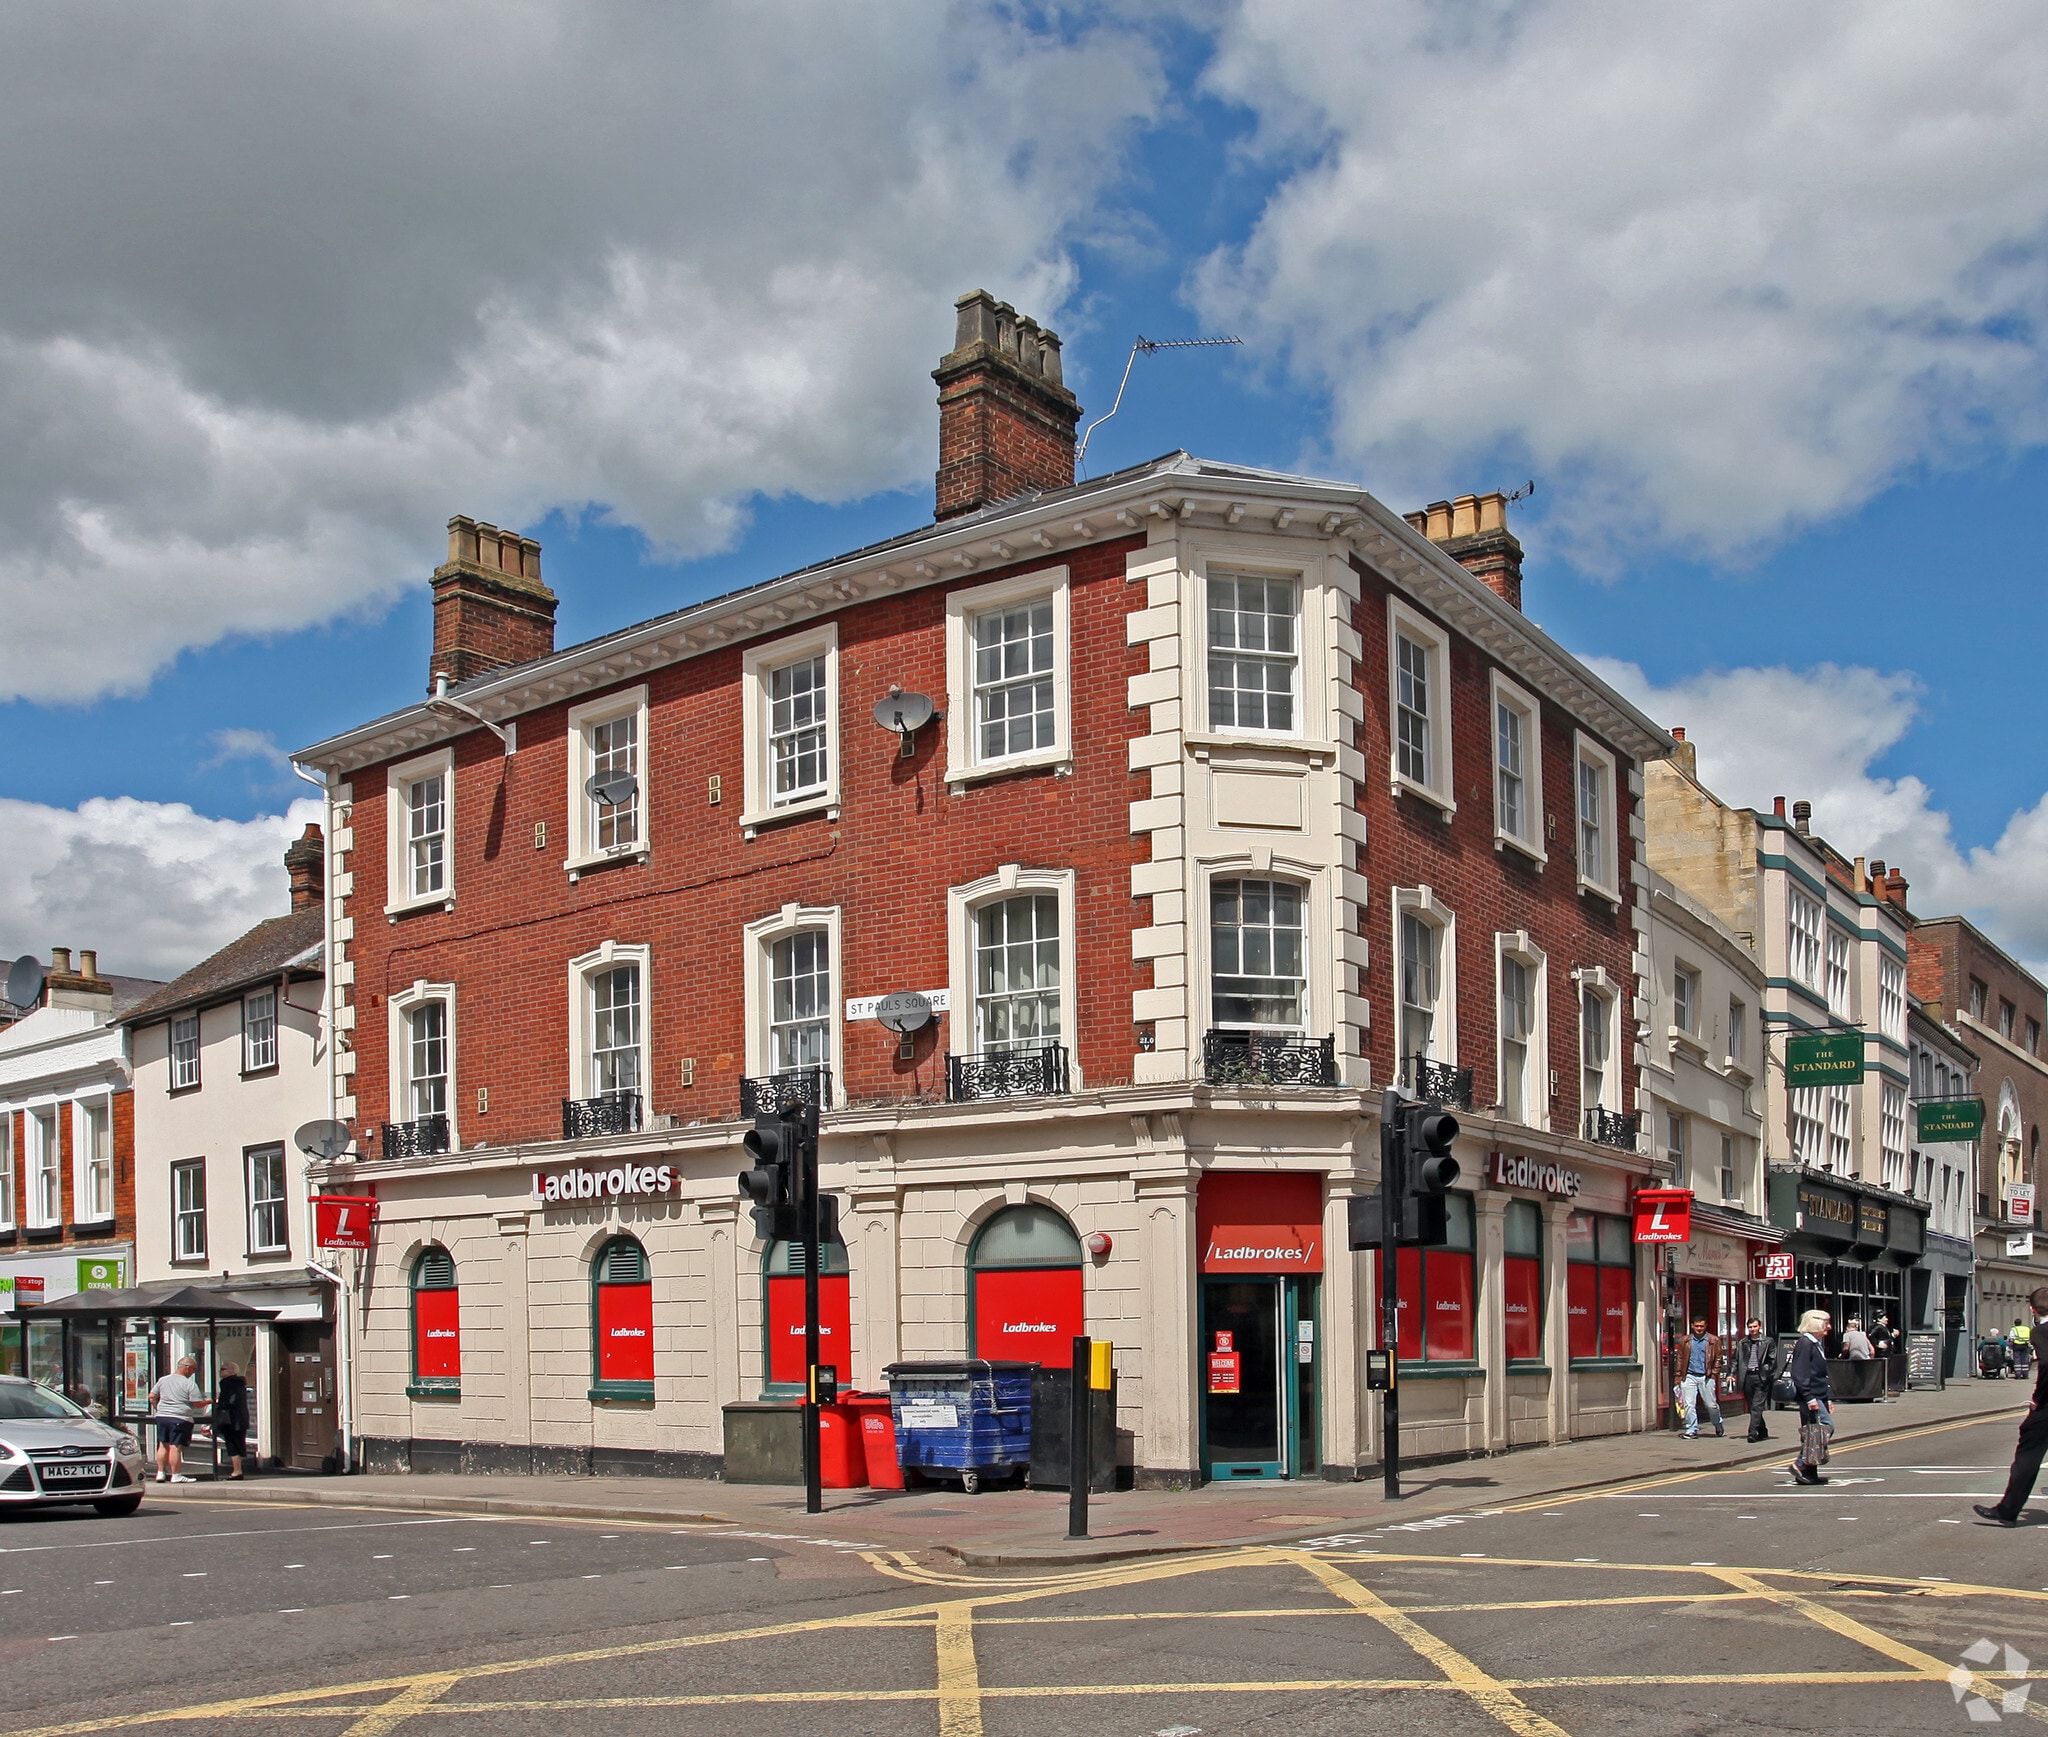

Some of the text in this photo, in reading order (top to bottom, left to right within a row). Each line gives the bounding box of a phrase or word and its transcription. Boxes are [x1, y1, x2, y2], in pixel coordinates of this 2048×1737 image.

[868, 1000, 900, 1012] PAULS
[905, 995, 946, 1009] SQUARE
[1793, 1060, 1856, 1072] STANDARD
[1924, 1122, 1974, 1131] STANDARD
[1496, 1153, 1582, 1197] Ladbrokes
[533, 1163, 672, 1202] Ladbrokes
[1808, 1195, 1854, 1224] STANDARD
[336, 1207, 353, 1235] L
[1651, 1202, 1670, 1230] L
[1638, 1232, 1682, 1241] Ladbrokes
[324, 1238, 365, 1247] Ladbrokes
[1758, 1256, 1790, 1267] JUST
[1766, 1267, 1790, 1278] EAT
[28, 1278, 43, 1286] stop
[88, 1282, 112, 1290] OXFAM
[1436, 1300, 1461, 1311] Ladbrokes
[1506, 1304, 1528, 1313] Ladbrokes
[611, 1327, 646, 1337] Ladbrokes
[790, 1325, 831, 1335] Ladkes
[1003, 1322, 1057, 1333] Ladbrokes
[427, 1329, 456, 1338] Ladbrokes
[48, 1465, 101, 1477] MA62 TKC
